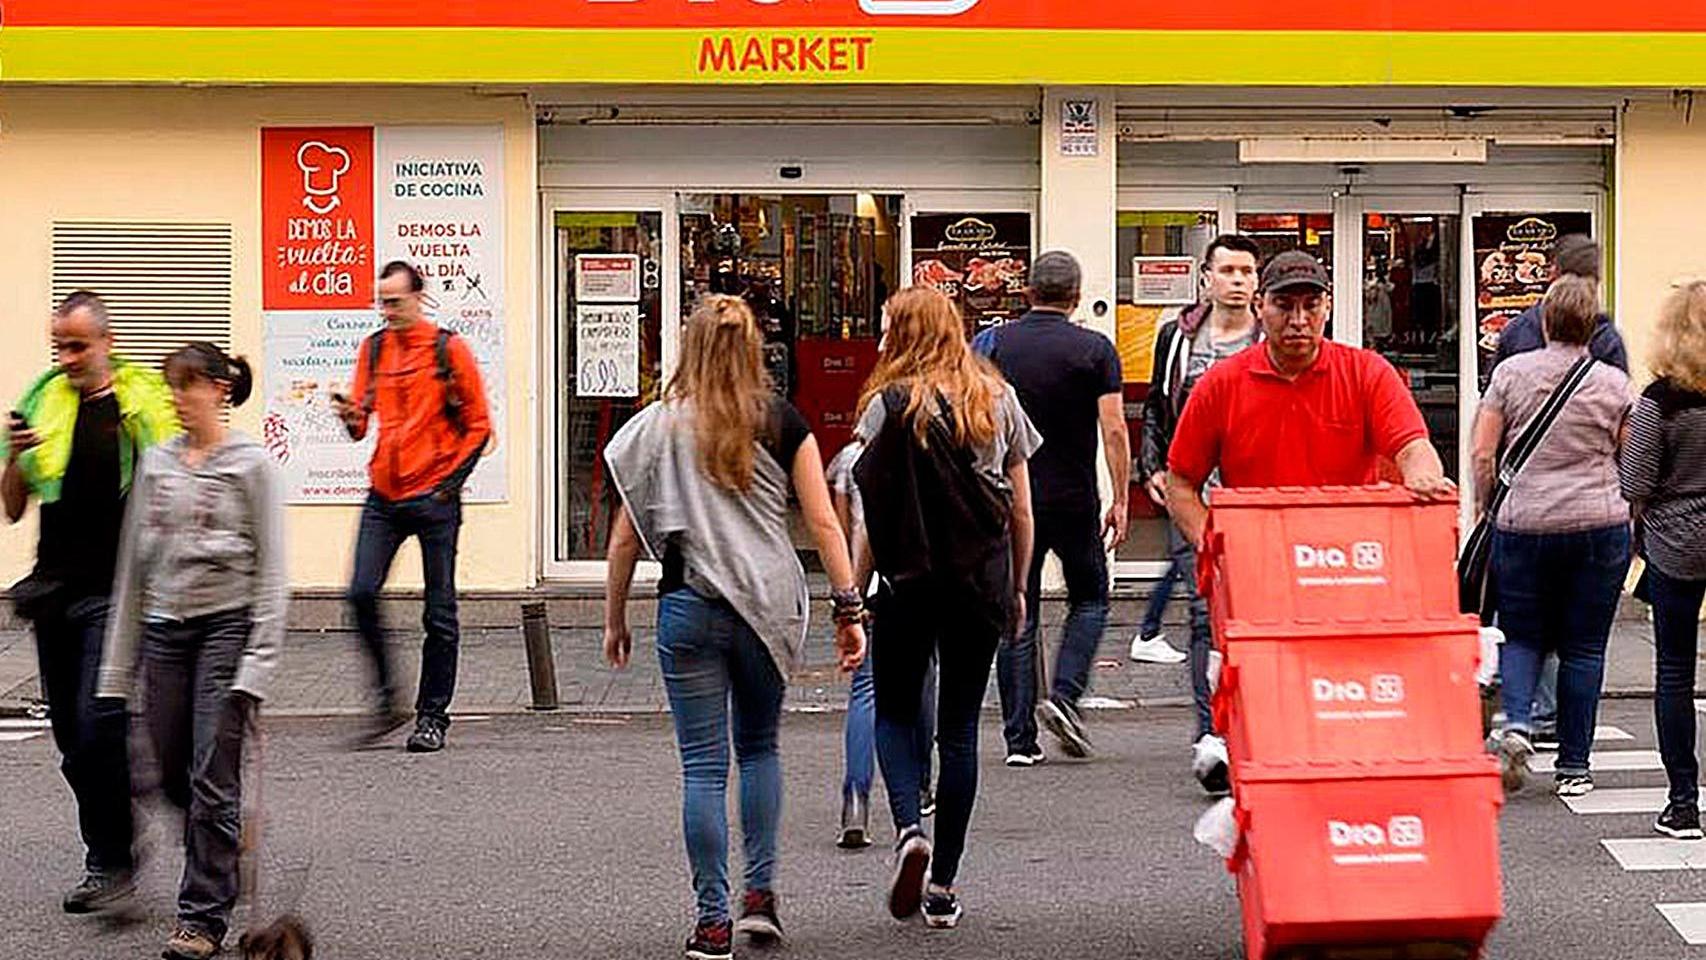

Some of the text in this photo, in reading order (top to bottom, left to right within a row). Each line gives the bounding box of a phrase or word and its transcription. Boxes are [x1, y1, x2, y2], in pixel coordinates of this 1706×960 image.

[699, 37, 873, 71] MARKET
[396, 162, 482, 177] INICIATIVA
[395, 184, 483, 197] DE COCINA
[288, 219, 356, 240] DEMOS LA
[398, 224, 481, 238] DEMOS LA
[286, 242, 358, 266] vuelta
[408, 243, 470, 257] VUELTA
[415, 261, 466, 277] AL DÍA
[289, 271, 309, 293] al
